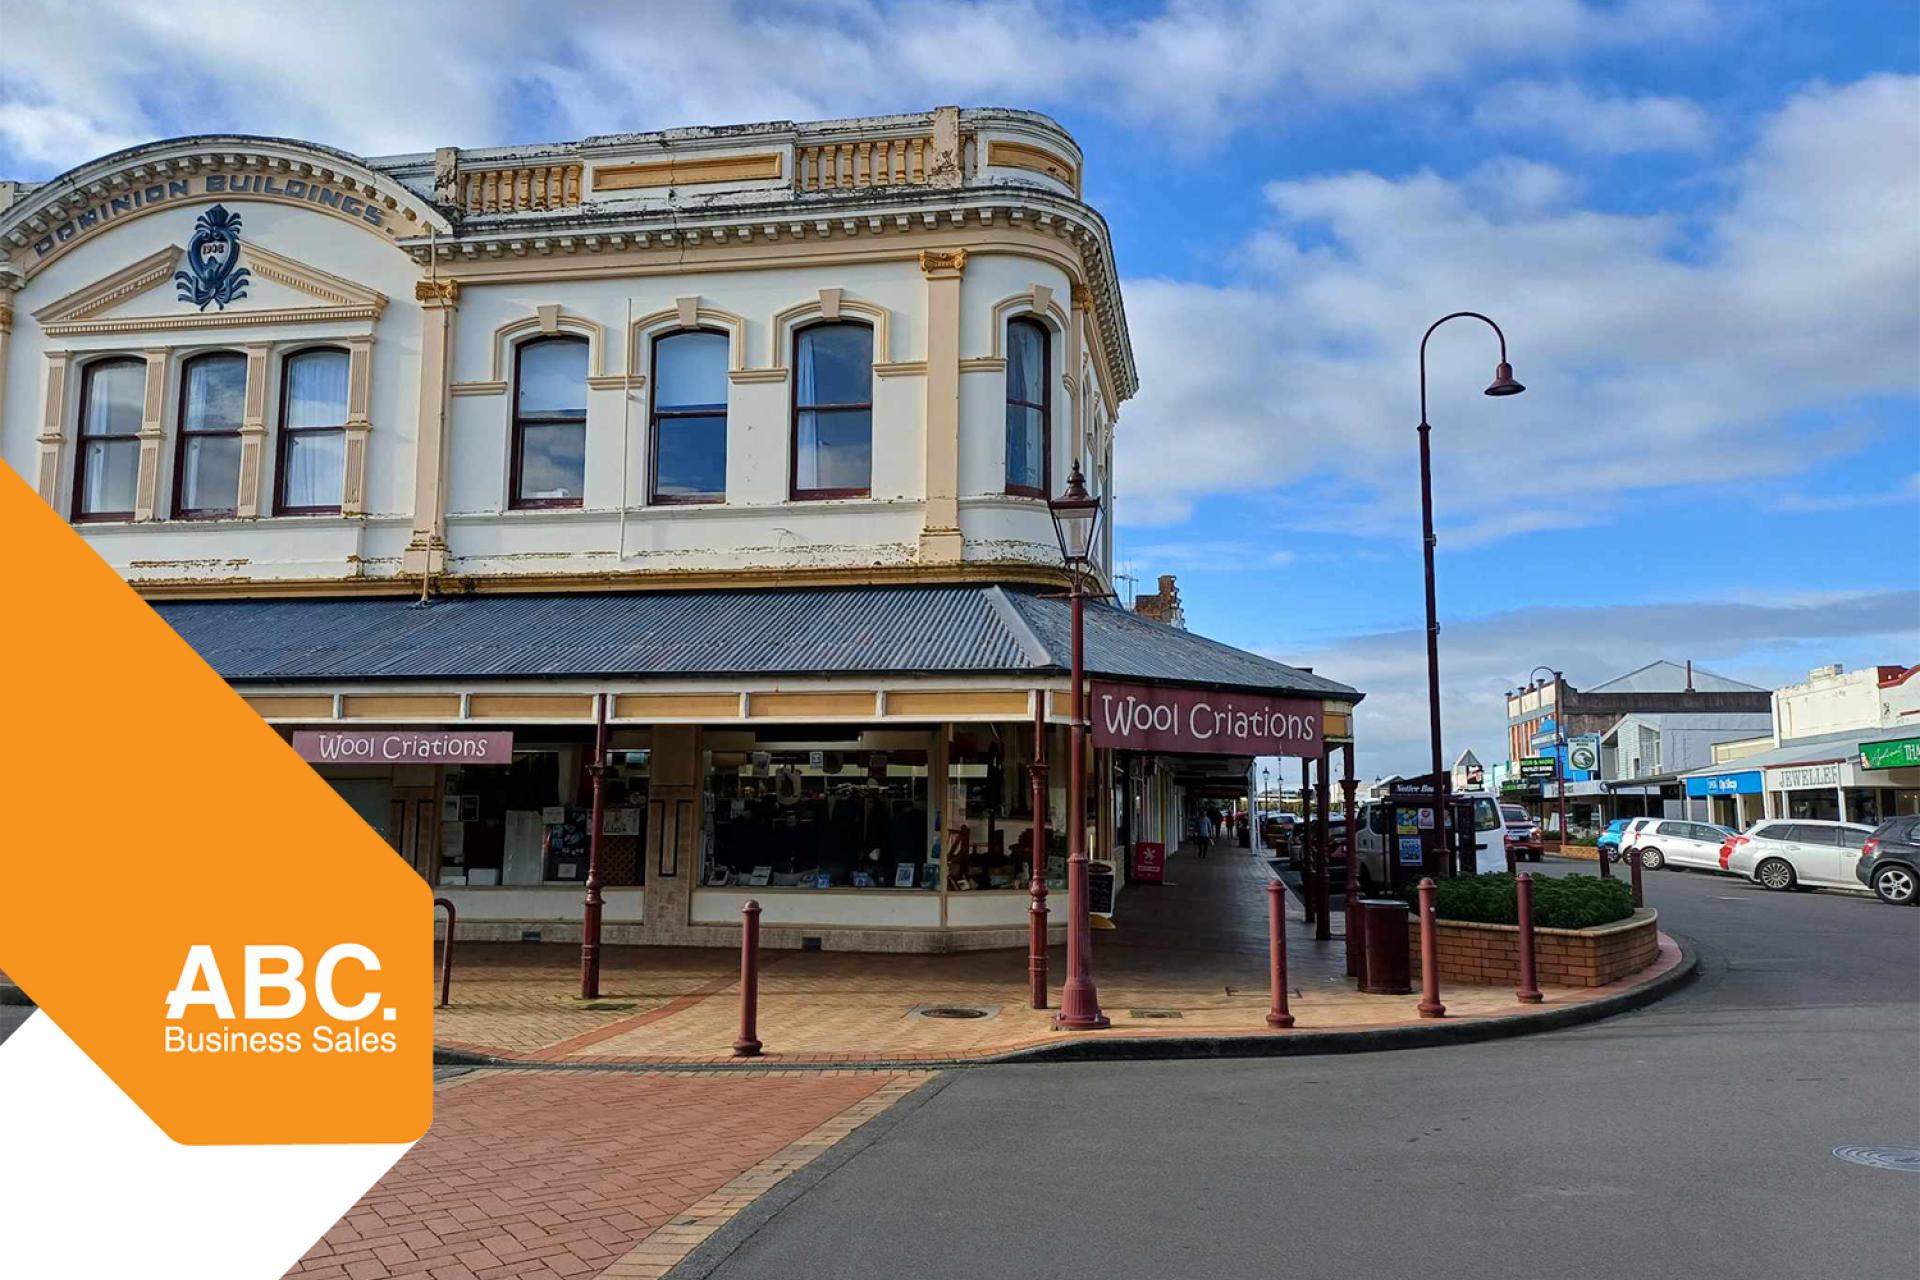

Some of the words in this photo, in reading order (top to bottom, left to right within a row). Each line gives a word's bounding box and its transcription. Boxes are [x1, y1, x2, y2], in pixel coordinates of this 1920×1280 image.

[33, 178, 188, 257] DOMINION
[1102, 695, 1179, 737] Wool
[1190, 703, 1316, 741] Criations
[319, 735, 375, 760] Wool
[383, 735, 488, 759] Criations
